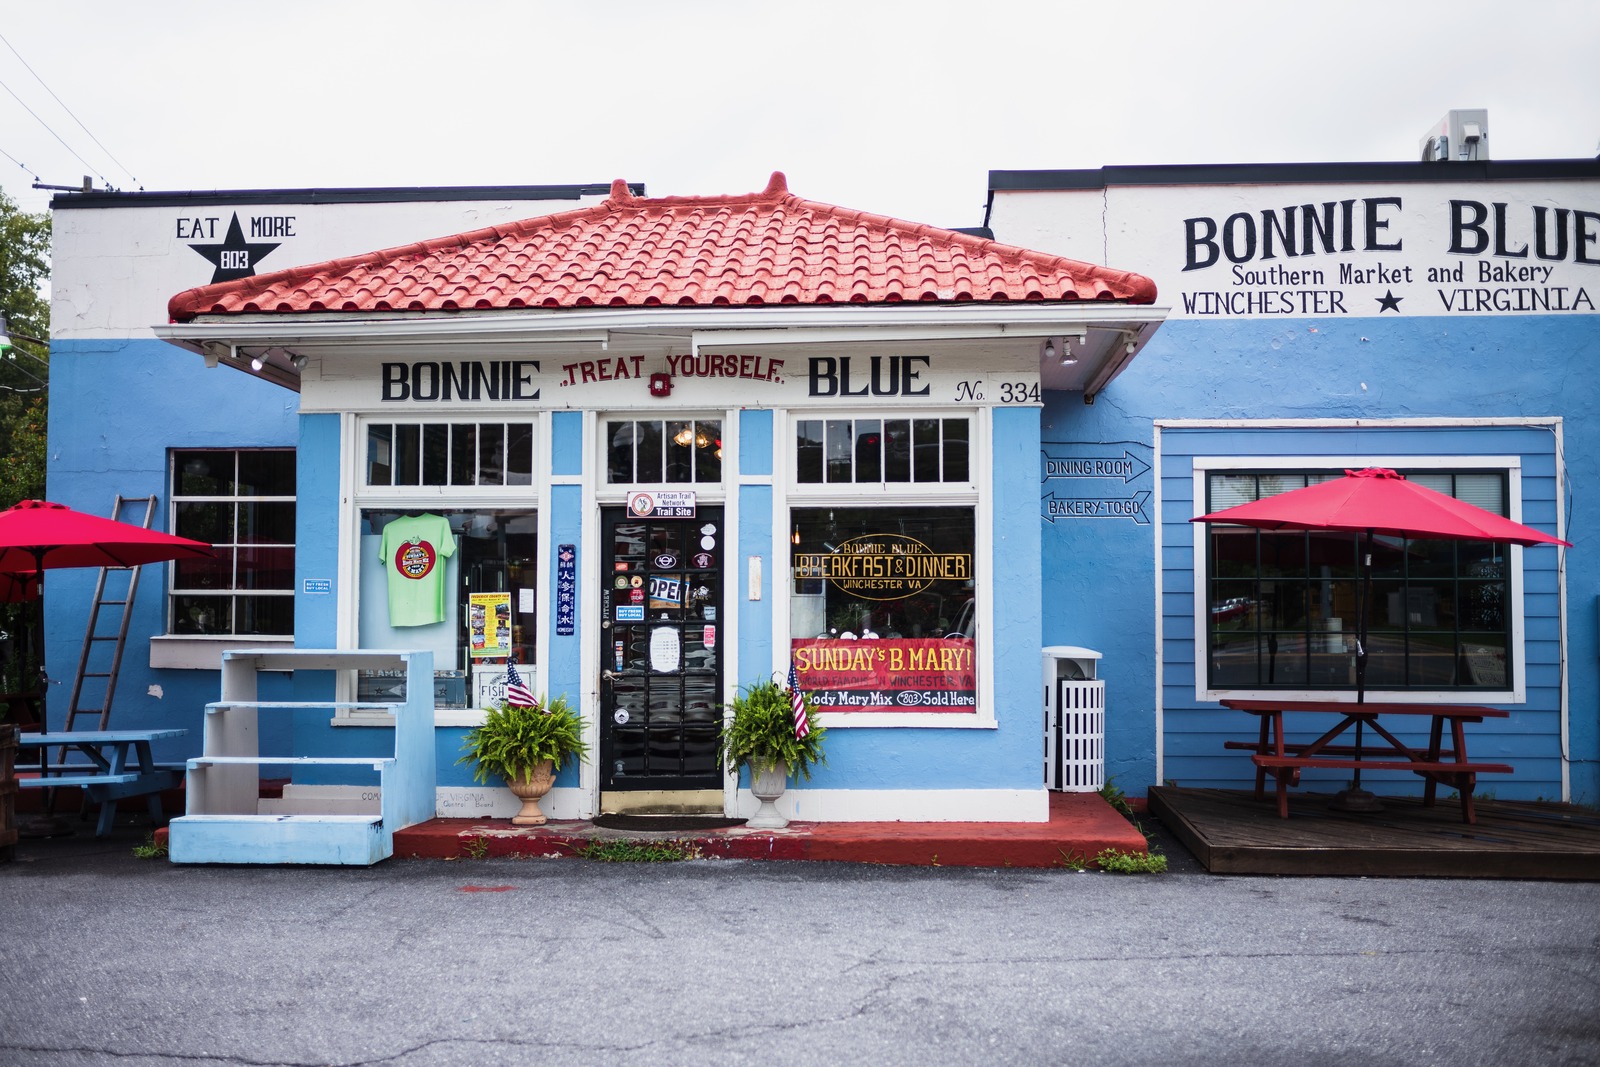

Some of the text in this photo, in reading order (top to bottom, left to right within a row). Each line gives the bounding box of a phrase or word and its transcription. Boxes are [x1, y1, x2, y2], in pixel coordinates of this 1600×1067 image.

[176, 216, 296, 239] EAT MORE
[1182, 197, 1600, 272] BONNIE BLUE
[220, 250, 249, 270] 803
[1232, 261, 1554, 286] Southern Market and Bakery
[1181, 287, 1596, 315] WINCHESTER VIRGINIA
[381, 356, 930, 402] BONNIE BLUE
[1000, 382, 1041, 403] 334
[1095, 460, 1133, 475] ROOM
[656, 507, 692, 516] Trail Site
[843, 543, 922, 554] BONNIE BLUE
[799, 556, 966, 577] BREAKFAST & DINNER
[843, 579, 921, 589] WINCHESTER VA
[908, 647, 971, 671] MARY!
[481, 685, 505, 697] FISH
[838, 691, 869, 706] Mary
[870, 691, 893, 705] Mix
[922, 691, 949, 706] Sold
[950, 691, 975, 706] Here
